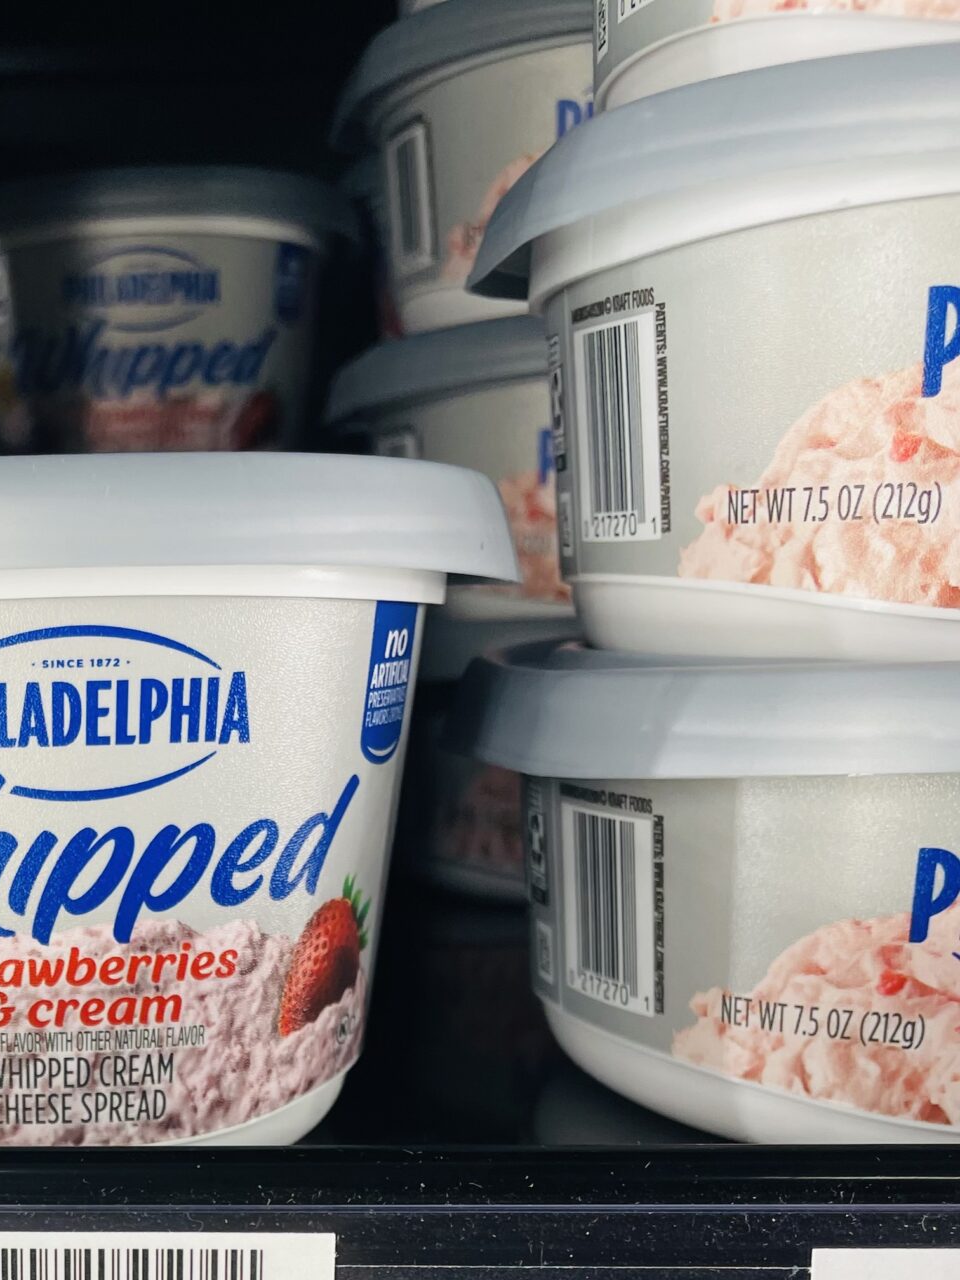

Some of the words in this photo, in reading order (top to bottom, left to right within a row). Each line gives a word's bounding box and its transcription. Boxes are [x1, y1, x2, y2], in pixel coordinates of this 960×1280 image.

[728, 489, 758, 525] NET
[765, 487, 795, 523] WT
[802, 485, 830, 521] 7.5
[837, 484, 866, 519] OZ
[872, 481, 942, 524] (212g)
[384, 628, 409, 659] no
[42, 659, 84, 669] SINCE
[90, 658, 120, 668] 1872
[22, 993, 183, 1027] cream
[721, 994, 752, 1029] NET
[758, 1000, 787, 1034] WT
[794, 1005, 819, 1038] 7.5
[826, 1008, 853, 1042] OZ
[859, 1007, 926, 1049] (212g)
[0, 1031, 41, 1052] FLAVOR
[45, 1030, 73, 1051] WITH
[76, 1030, 111, 1051] OTHER
[114, 1027, 163, 1049] NATURAL
[165, 1025, 205, 1047] FLAVOR
[99, 1052, 174, 1086] CREAM
[81, 1090, 167, 1123] SPREAD
